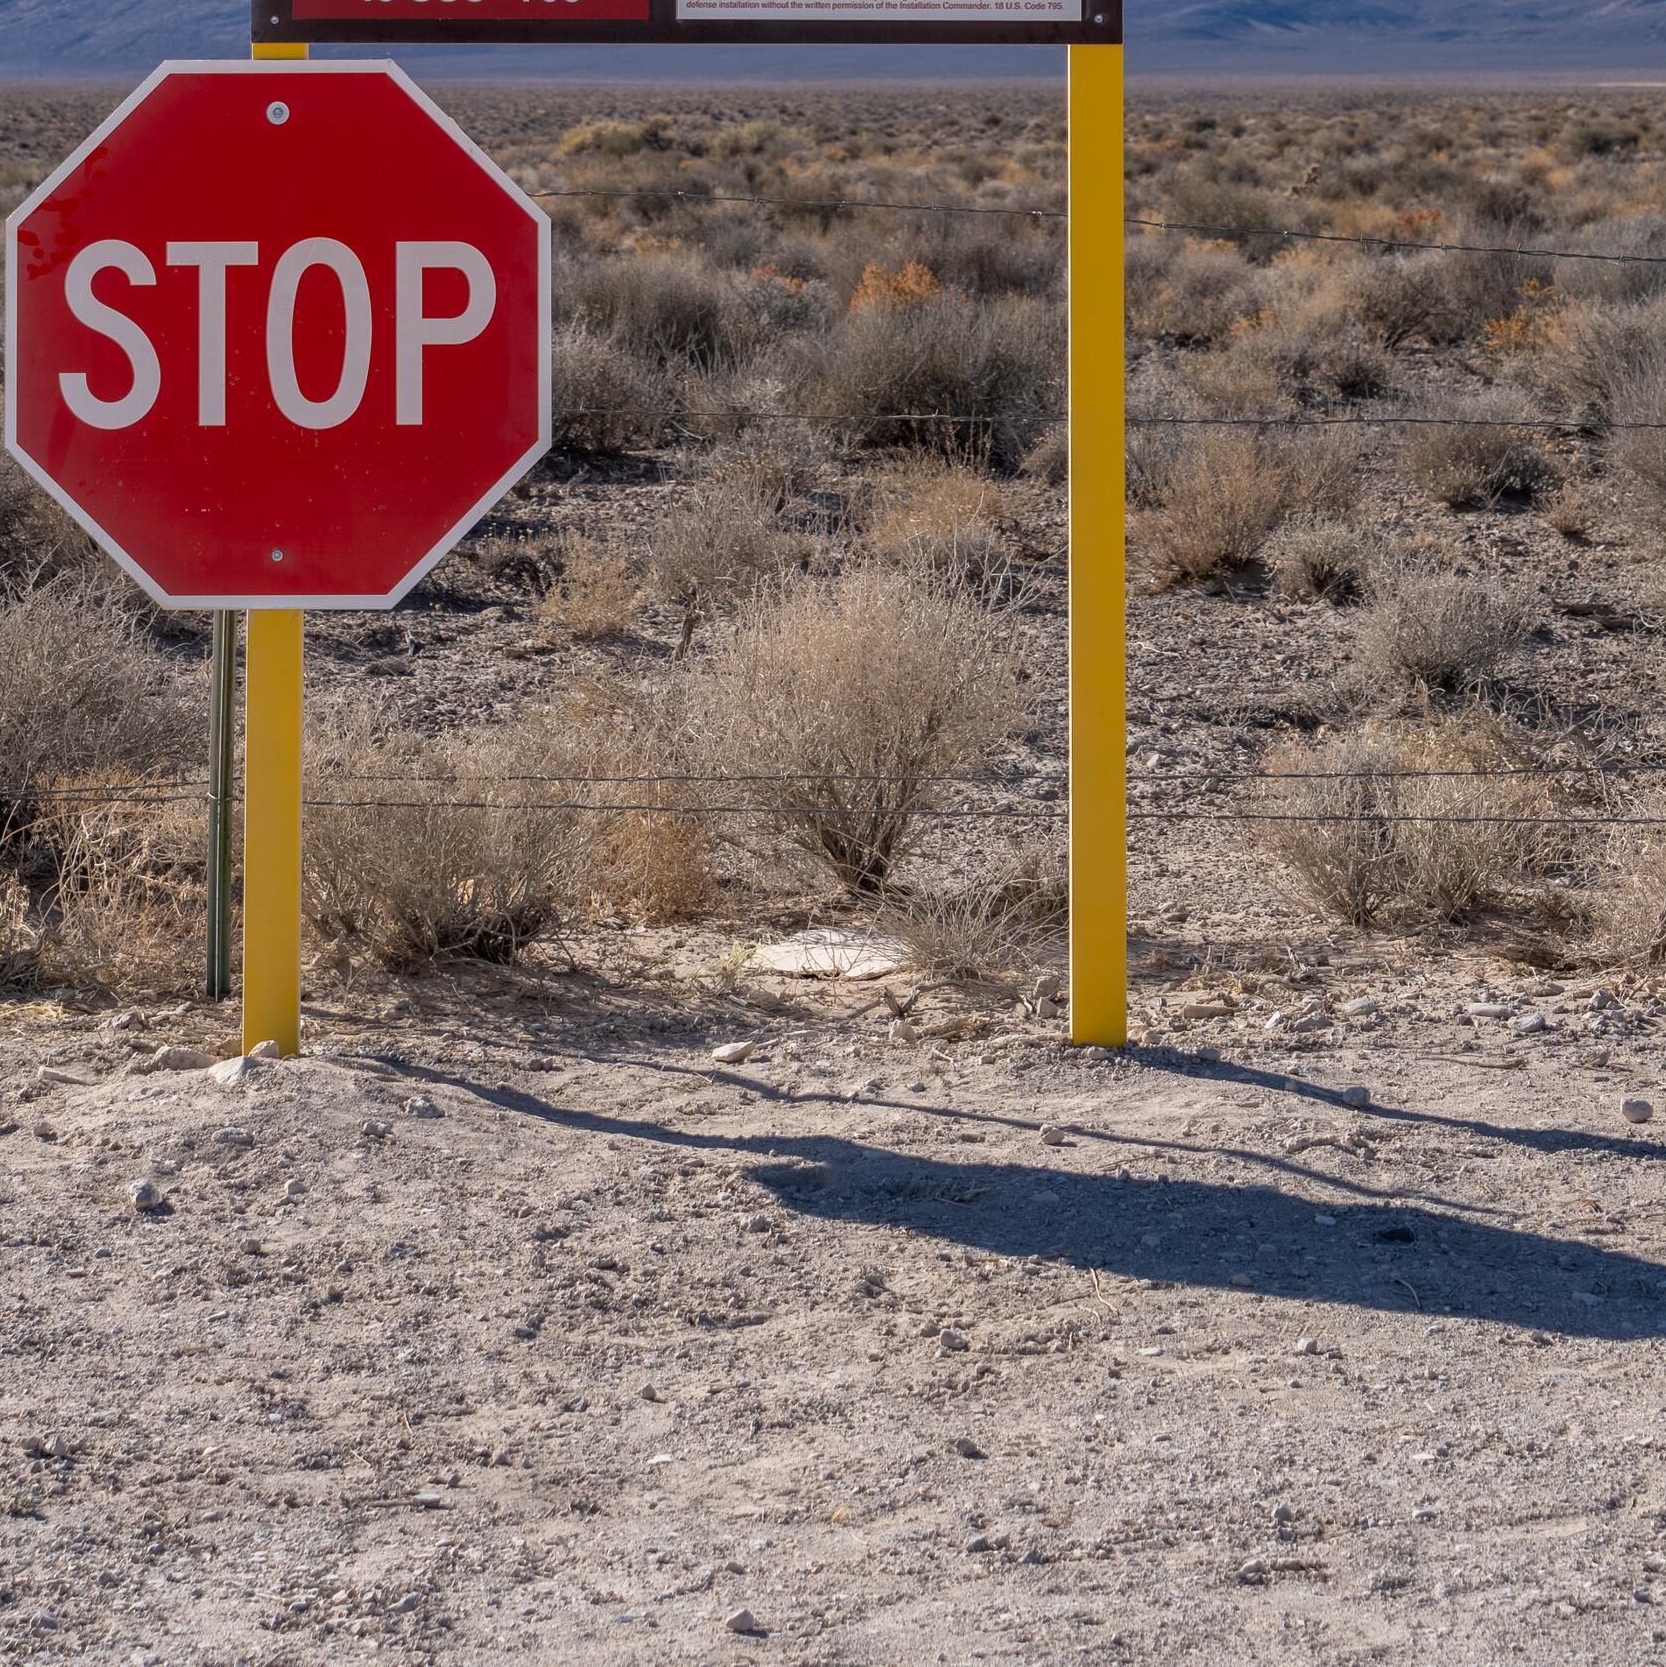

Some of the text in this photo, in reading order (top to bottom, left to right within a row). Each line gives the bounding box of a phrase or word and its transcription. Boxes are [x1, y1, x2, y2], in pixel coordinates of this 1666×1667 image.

[718, 1, 760, 9] installation
[760, 1, 789, 9] without
[790, 1, 803, 9] the
[831, 2, 874, 11] permission
[994, 2, 1004, 10] 18
[1023, 2, 1046, 10] Code
[59, 237, 496, 429] STOP
